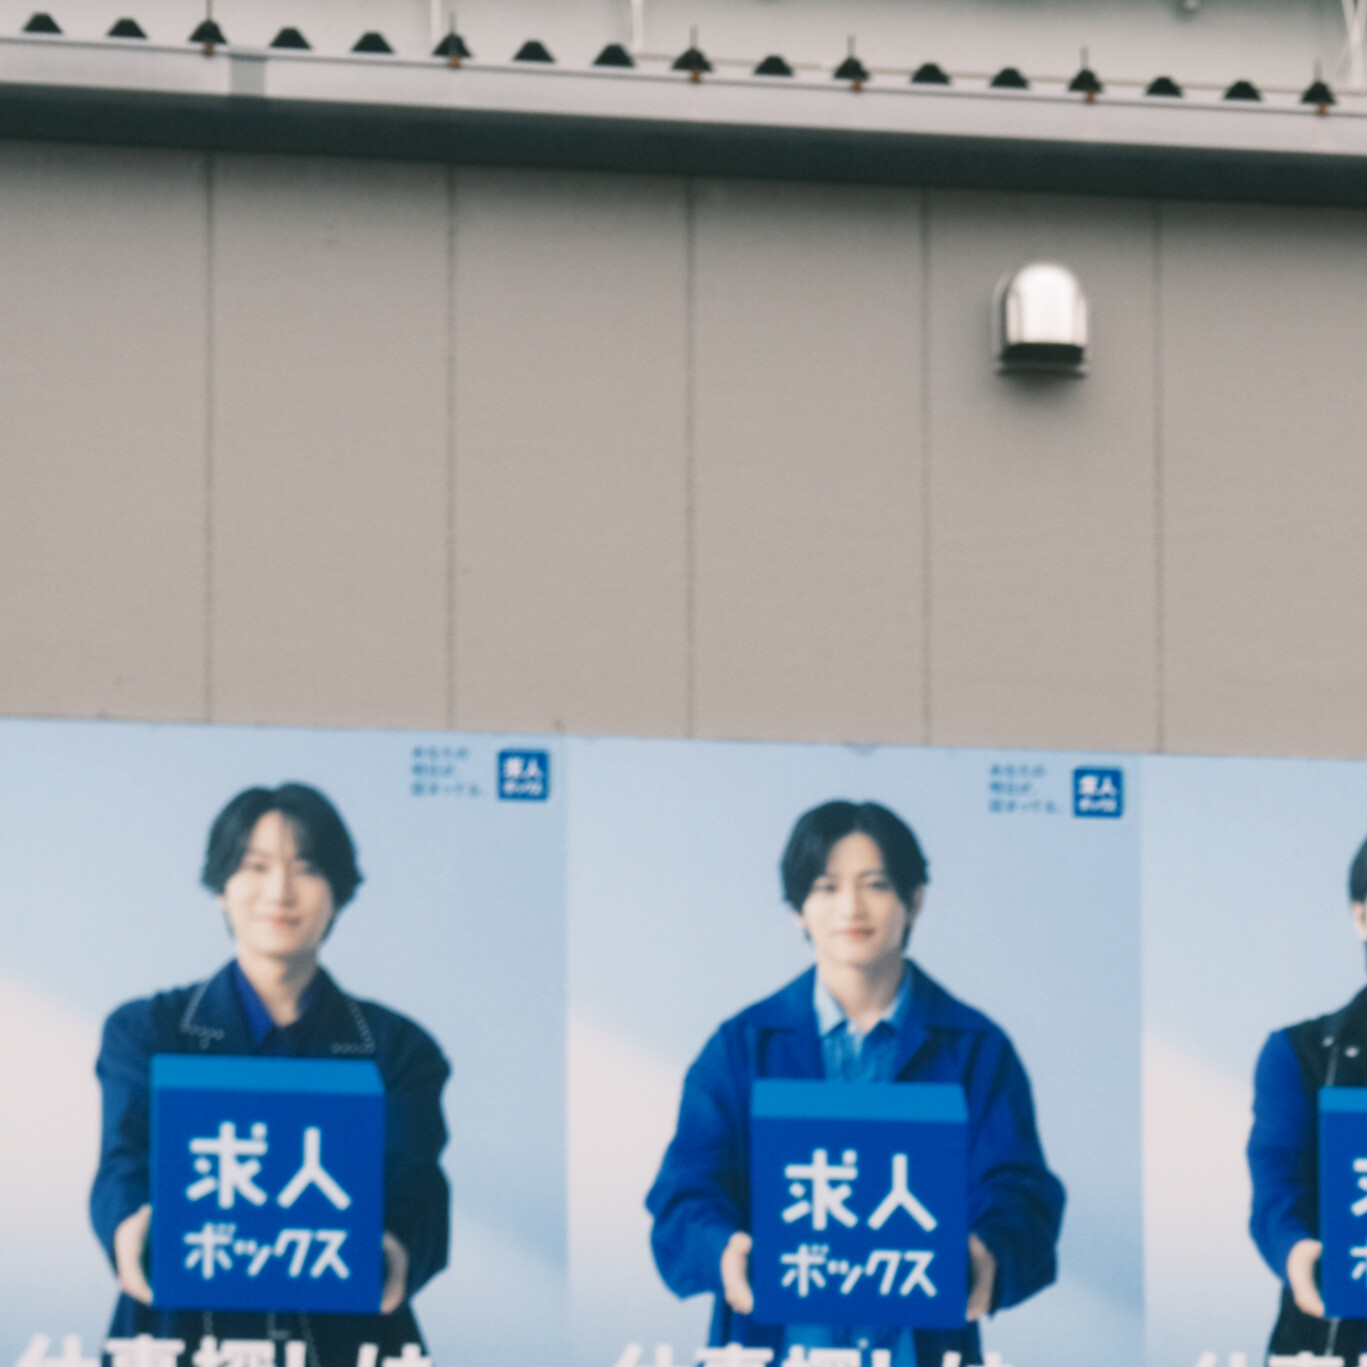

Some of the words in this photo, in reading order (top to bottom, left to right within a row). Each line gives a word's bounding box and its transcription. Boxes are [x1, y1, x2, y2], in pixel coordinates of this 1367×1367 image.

[186, 1121, 351, 1209] 求人
[782, 1149, 938, 1231] 求人
[184, 1223, 350, 1280] ボックス
[780, 1244, 937, 1298] ボックス
